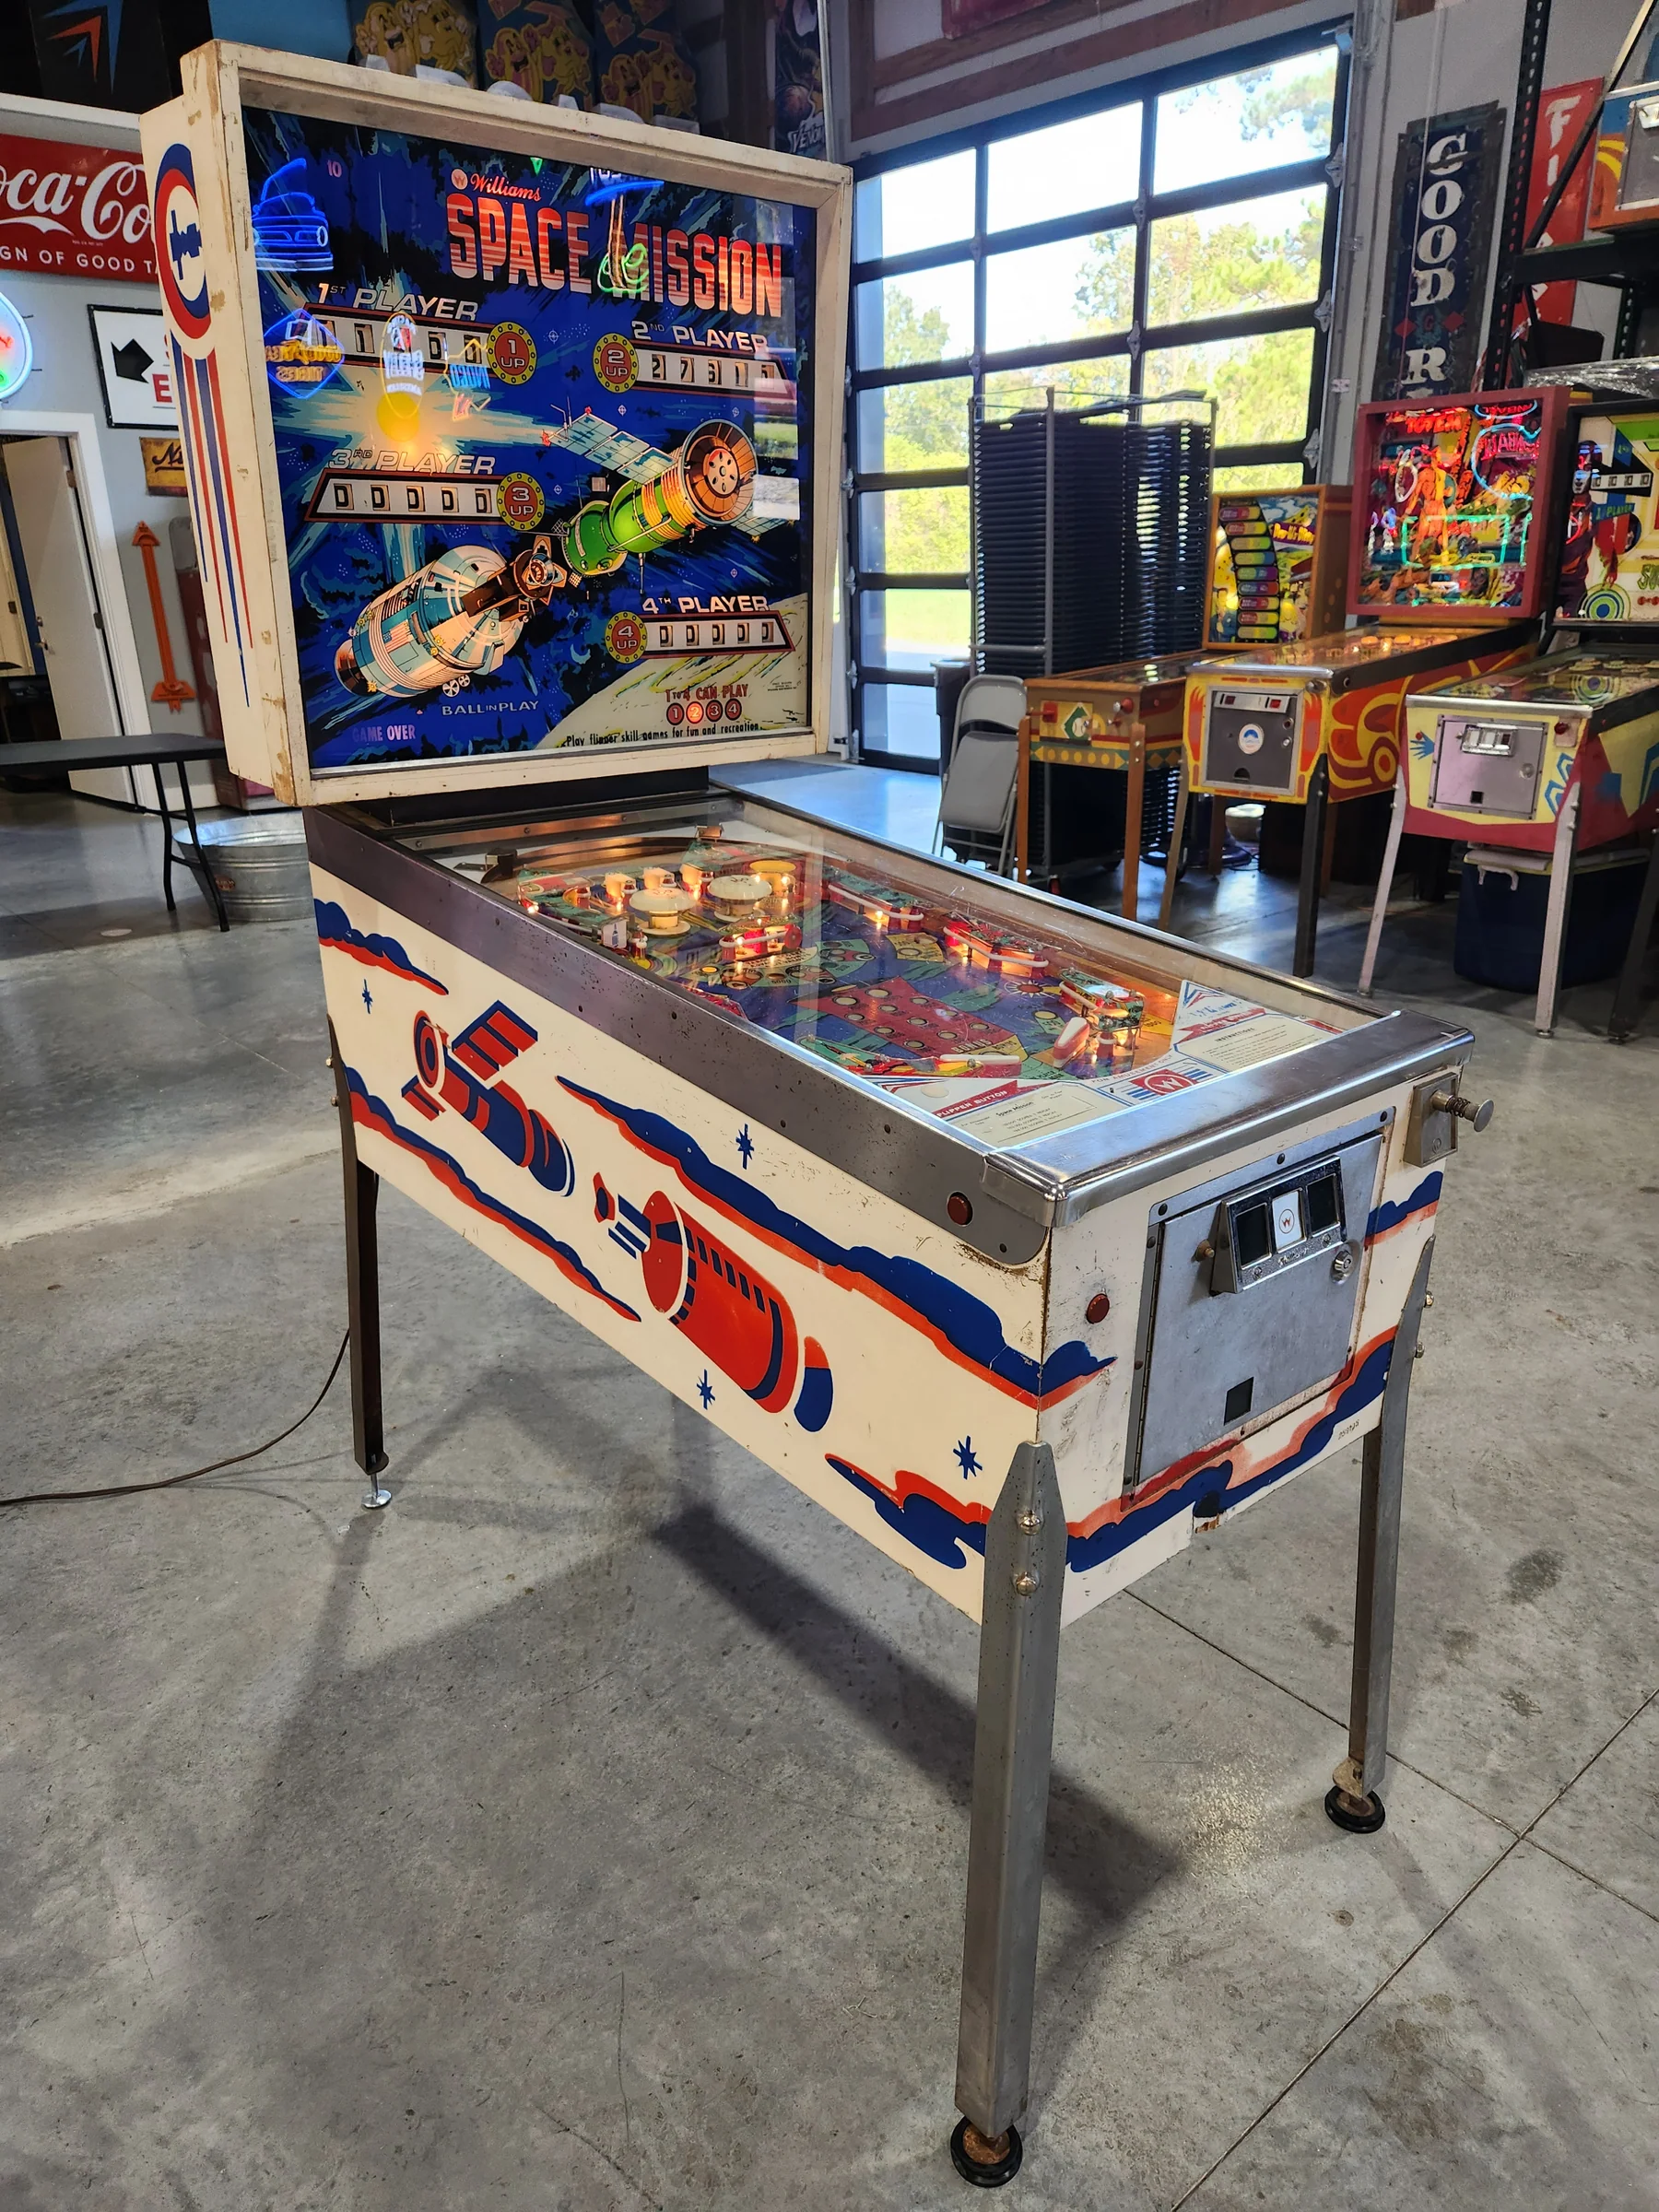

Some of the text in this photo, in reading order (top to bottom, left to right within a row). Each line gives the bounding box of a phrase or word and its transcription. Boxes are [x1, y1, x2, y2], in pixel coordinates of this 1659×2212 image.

[327, 159, 342, 178] 10
[470, 173, 542, 202] Williams
[39, 250, 65, 265] OF
[76, 253, 135, 272] GOOD
[446, 193, 782, 318] SPACE MISSION
[353, 288, 478, 321] PLAYER
[508, 339, 517, 354] 1
[672, 325, 769, 354] PLAYER
[500, 356, 525, 369] UP
[607, 349, 624, 366] 2
[606, 366, 629, 379] UP
[375, 450, 496, 475] PLAYER
[512, 487, 530, 501] 3
[510, 506, 534, 516] UP
[677, 594, 770, 613] PLAYER
[618, 625, 634, 639] 4
[617, 640, 638, 650] UP
[665, 689, 671, 702] 1
[682, 688, 691, 700] 4
[696, 686, 718, 700] CAN
[722, 684, 748, 699] PLAY
[441, 704, 485, 716] BALL
[499, 700, 539, 712] PLAY
[672, 703, 737, 719] 1 2 3 4
[352, 724, 416, 743] GAME OVER
[566, 735, 585, 747] Play
[621, 732, 639, 743] skill
[642, 730, 668, 741] games
[672, 726, 683, 738] for
[686, 725, 700, 736] fun
[702, 724, 716, 735] and
[951, 1039, 993, 1053] BONUS
[936, 1090, 1007, 1117] FLIPPER BUTTON
